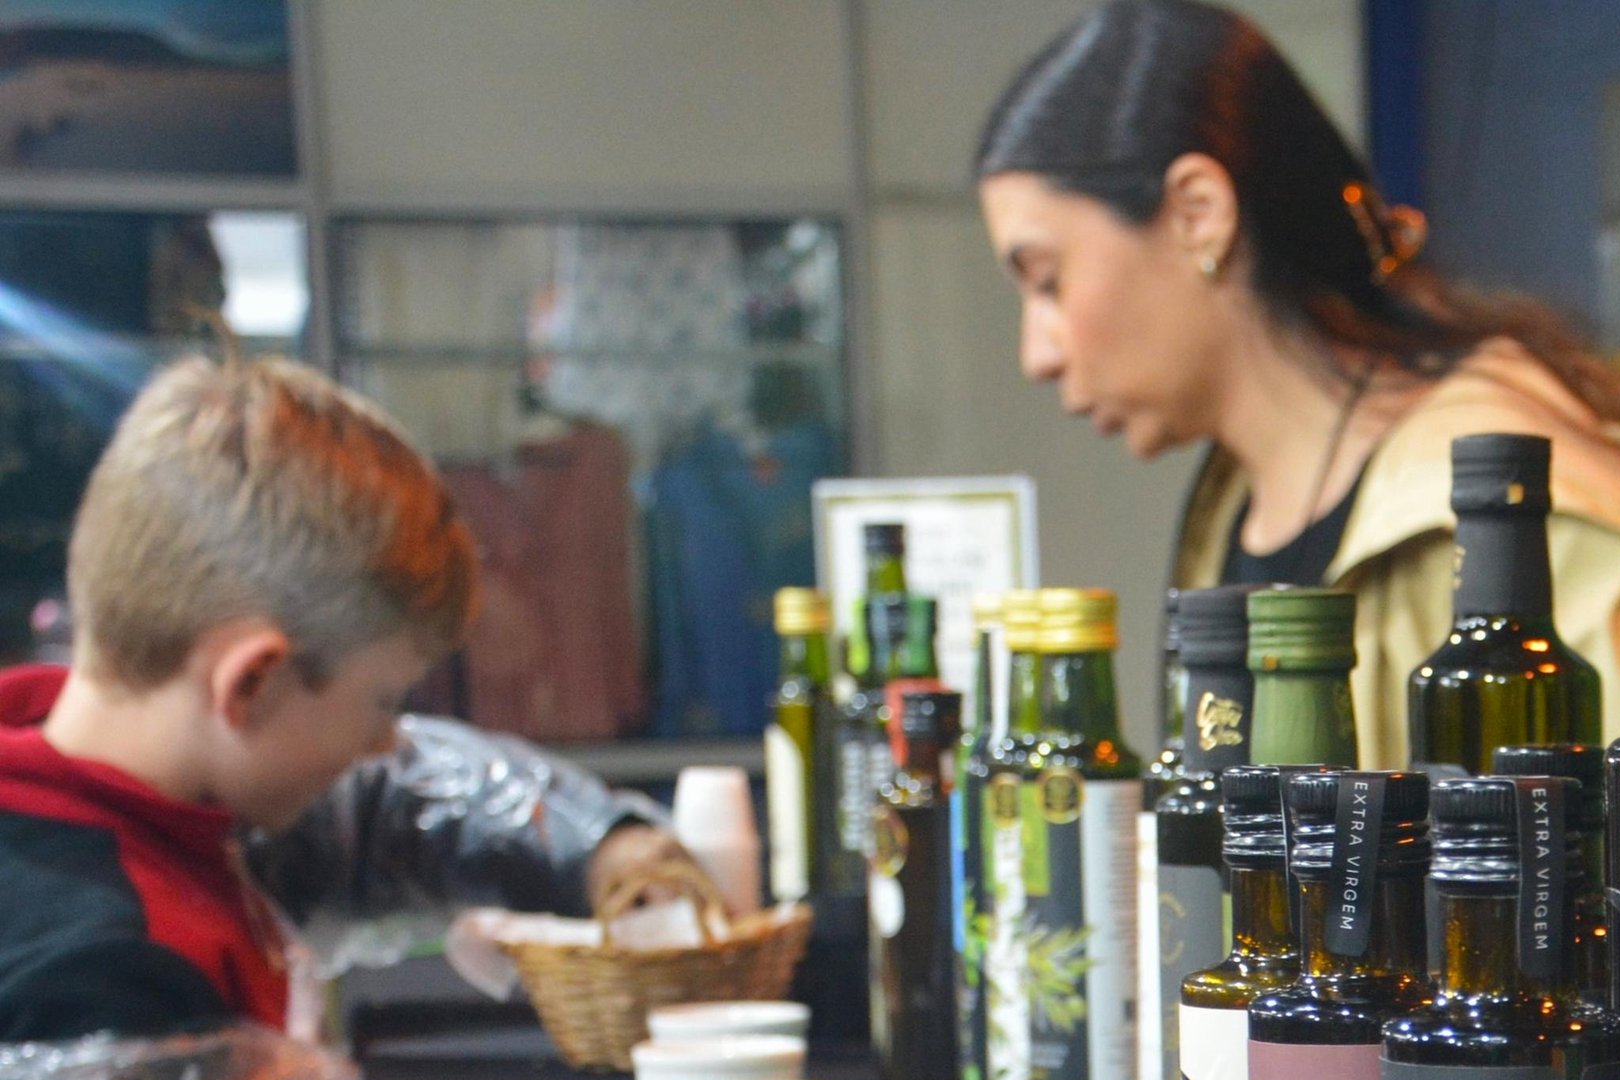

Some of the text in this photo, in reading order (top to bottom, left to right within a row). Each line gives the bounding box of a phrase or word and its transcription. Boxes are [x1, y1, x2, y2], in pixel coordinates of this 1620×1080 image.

[1340, 782, 1368, 930] EXTRA VIRGEM
[1532, 788, 1549, 950] EXTRA VIRGEM
